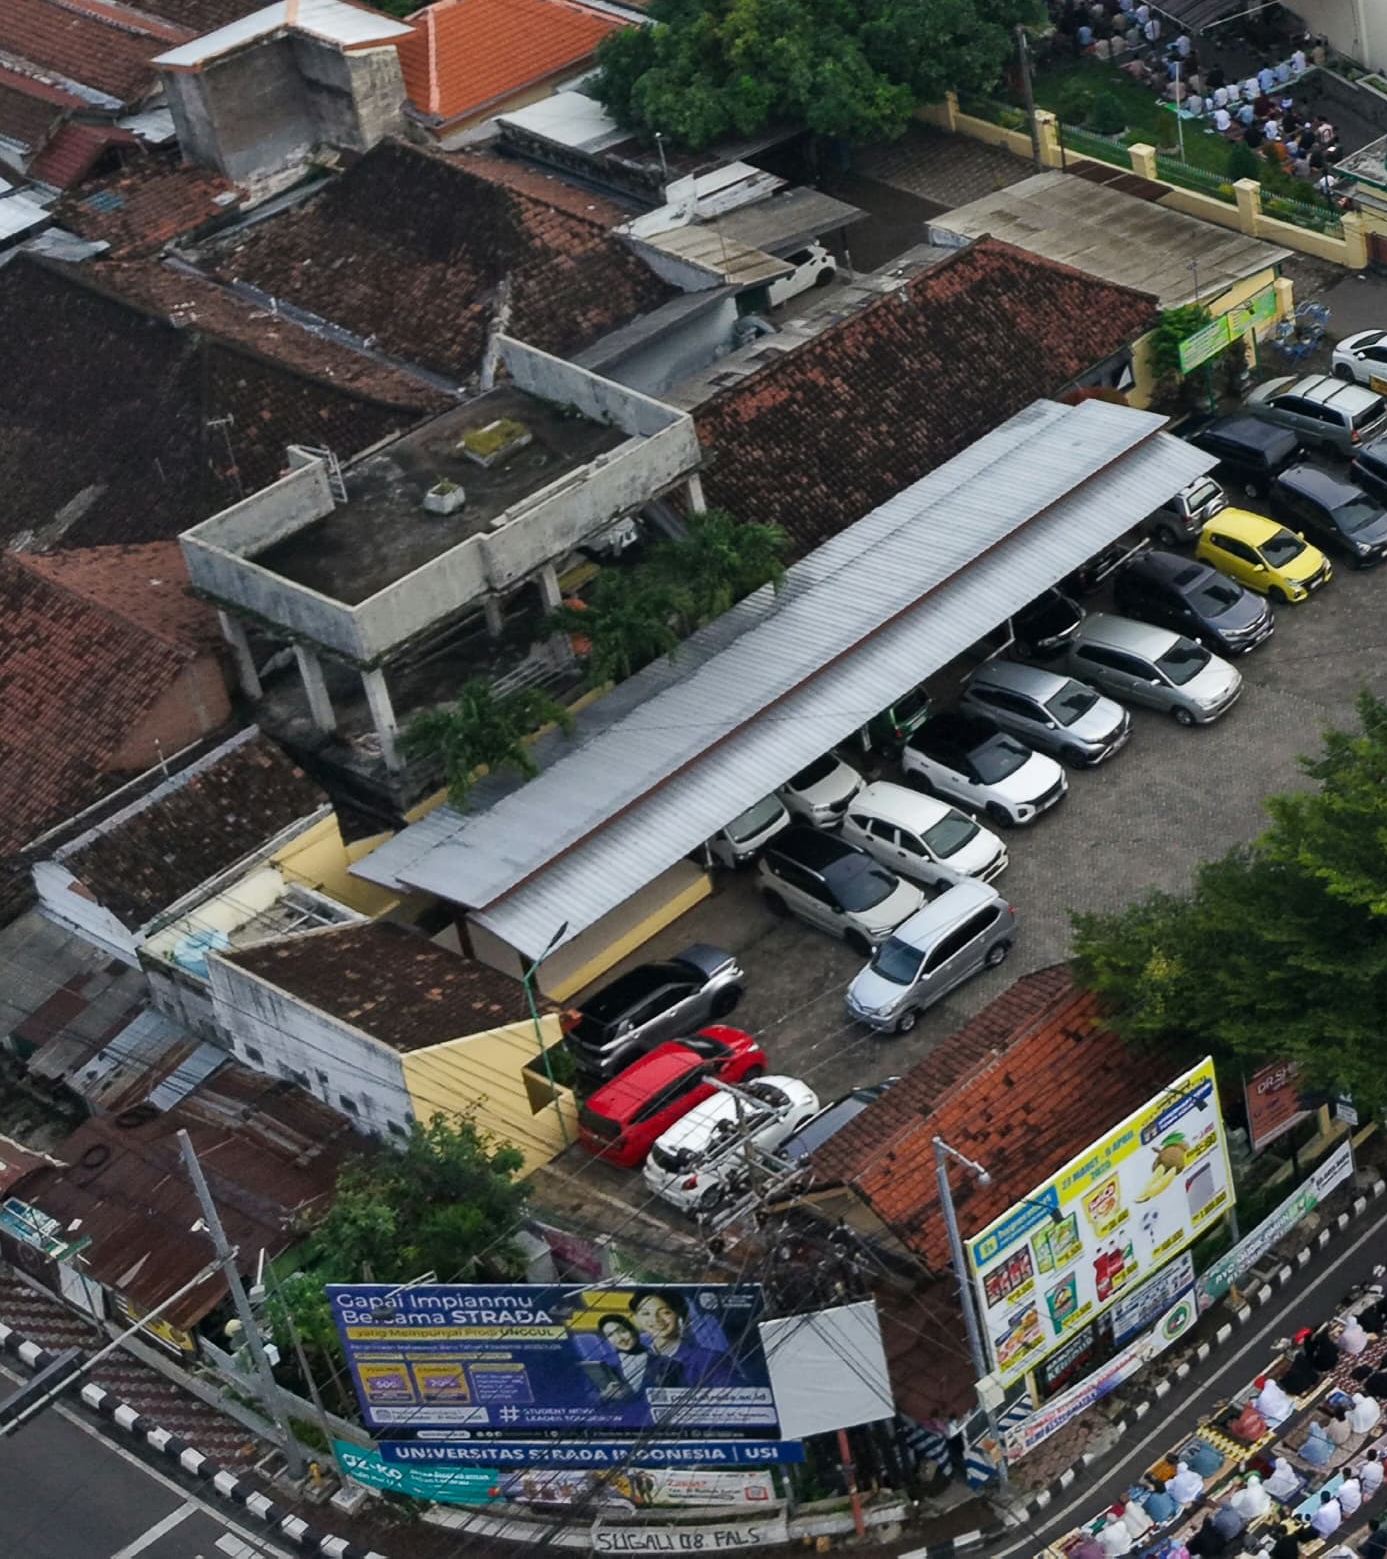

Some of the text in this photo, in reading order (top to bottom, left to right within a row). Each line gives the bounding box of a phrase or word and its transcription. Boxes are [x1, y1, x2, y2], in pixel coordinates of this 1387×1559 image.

[336, 1293, 534, 1313] Gapai Impianmu
[450, 1310, 553, 1325] STRADA
[395, 1446, 525, 1460] UNIVERSITAS
[528, 1448, 607, 1460] STRADA
[744, 1447, 779, 1458] USI
[714, 1527, 761, 1547] FALS
